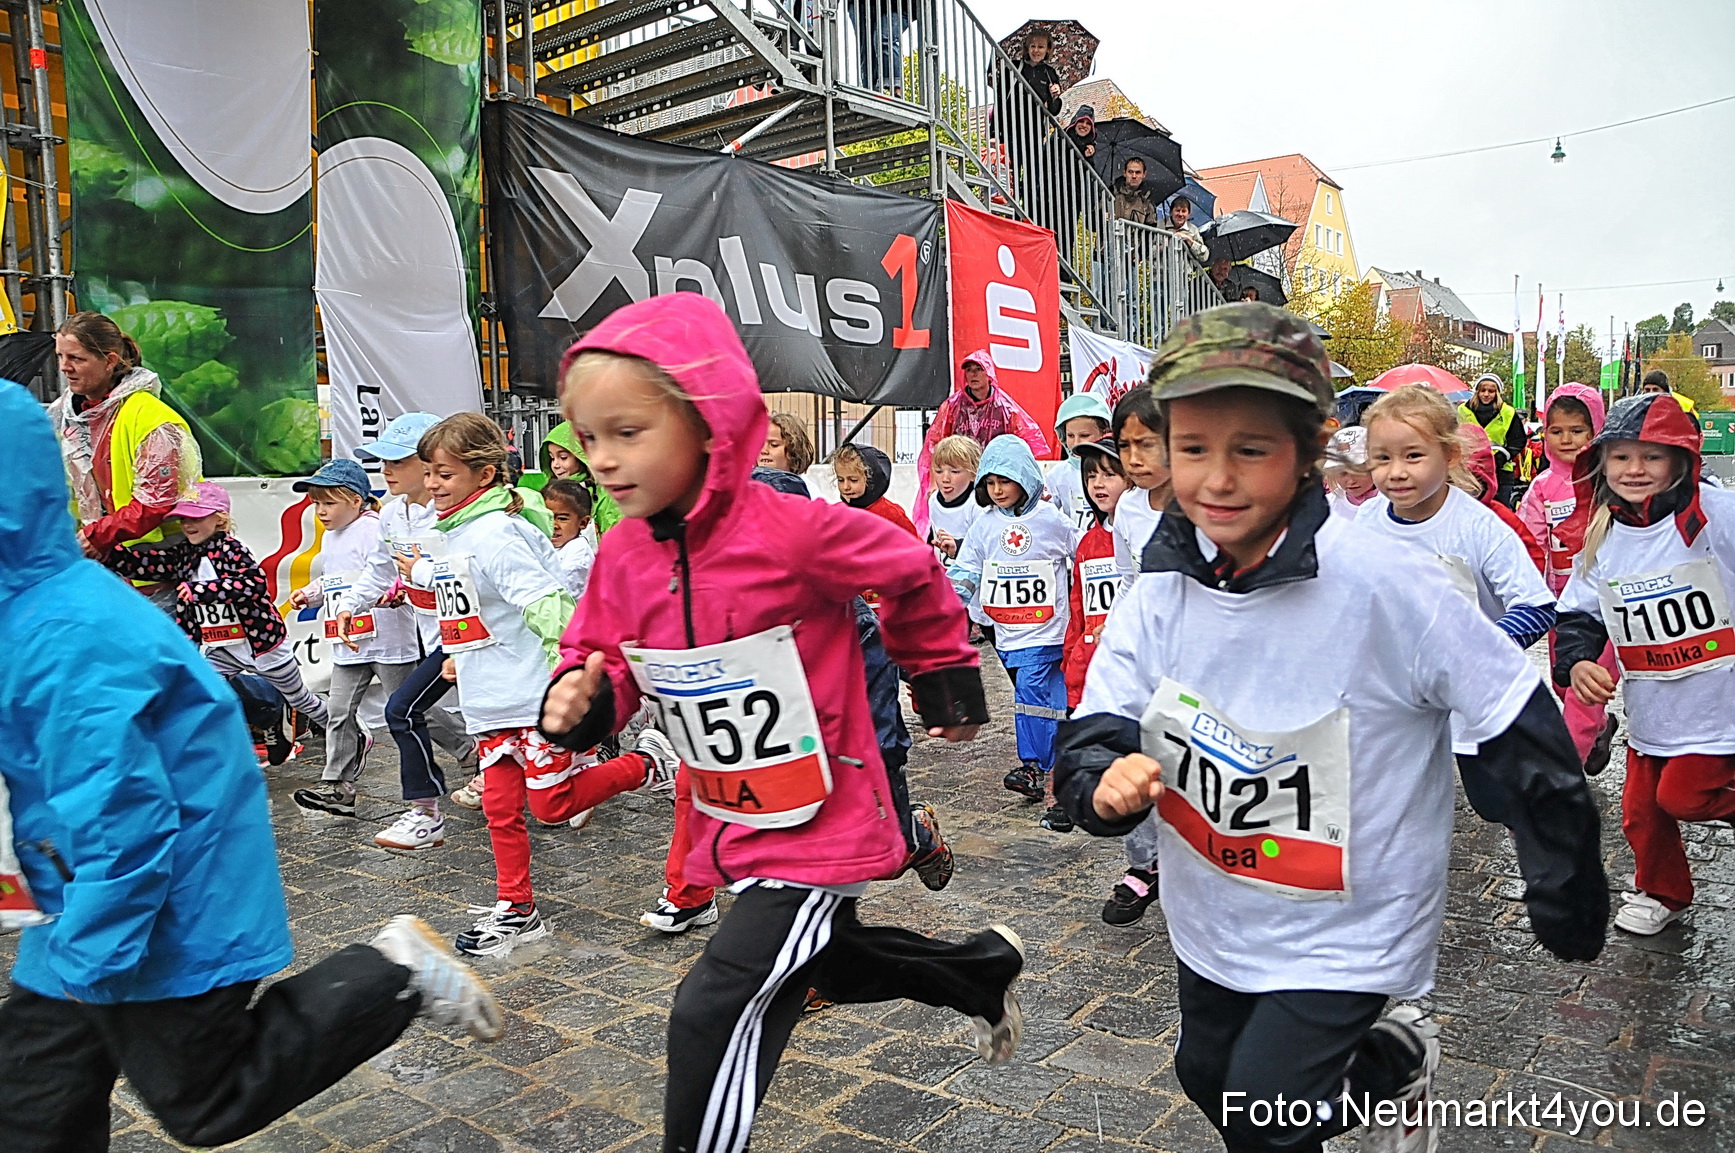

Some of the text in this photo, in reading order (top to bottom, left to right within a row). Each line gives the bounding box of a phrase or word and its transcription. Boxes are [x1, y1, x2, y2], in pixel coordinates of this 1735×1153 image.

[987, 579, 1047, 605] 7158
[1620, 575, 1673, 596] BOCK
[1612, 590, 1715, 643] 7100
[1645, 644, 1703, 667] Annika
[646, 659, 725, 684] BOCK
[1163, 730, 1311, 832] 7021
[1207, 833, 1257, 869] Lea
